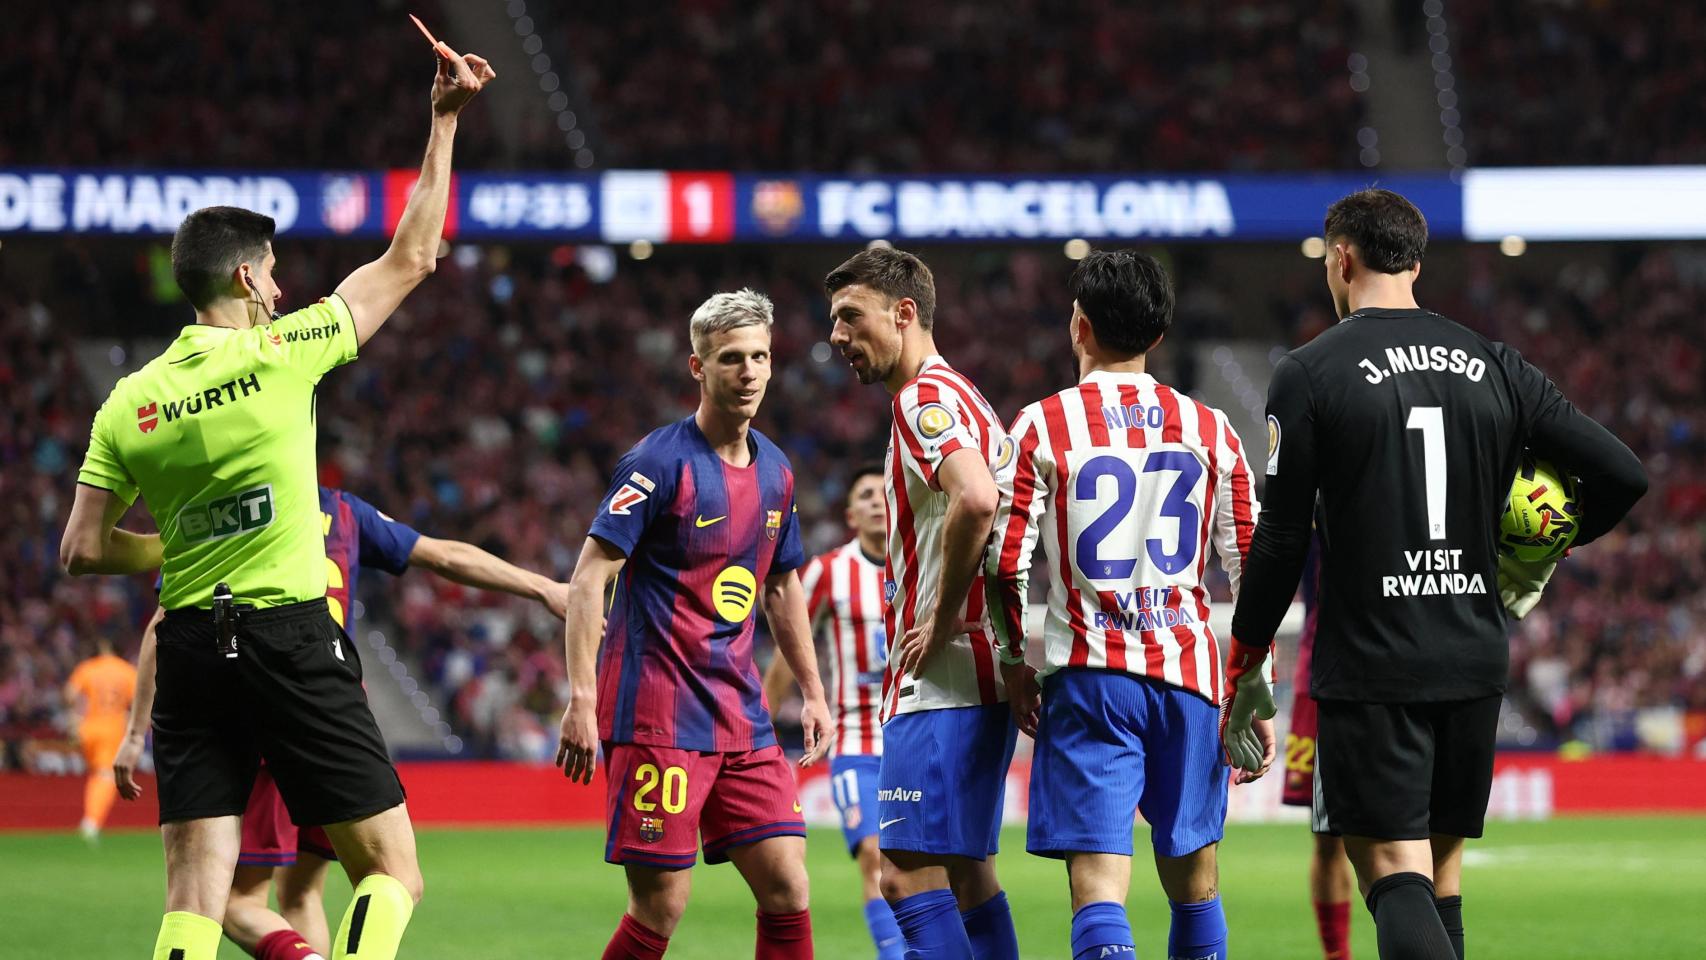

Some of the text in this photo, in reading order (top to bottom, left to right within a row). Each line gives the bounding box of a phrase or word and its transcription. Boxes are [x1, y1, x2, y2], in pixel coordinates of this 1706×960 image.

[0, 174, 66, 231] DE
[684, 181, 713, 236] 1
[817, 181, 1235, 237] FC BARCELONA
[282, 322, 341, 343] WÜRTH
[1358, 345, 1486, 384] J.MUSSO
[162, 373, 261, 422] WÜRTH
[1101, 404, 1164, 430] NICO
[1405, 406, 1447, 540] 1
[183, 492, 270, 537] BKT
[1075, 451, 1203, 580] 23
[1404, 549, 1462, 572] VISIT
[1115, 588, 1172, 611] VISIT
[1382, 573, 1486, 597] RWANDA
[1094, 607, 1194, 631] RWANDA
[633, 763, 688, 814] 20
[833, 769, 859, 808] 11
